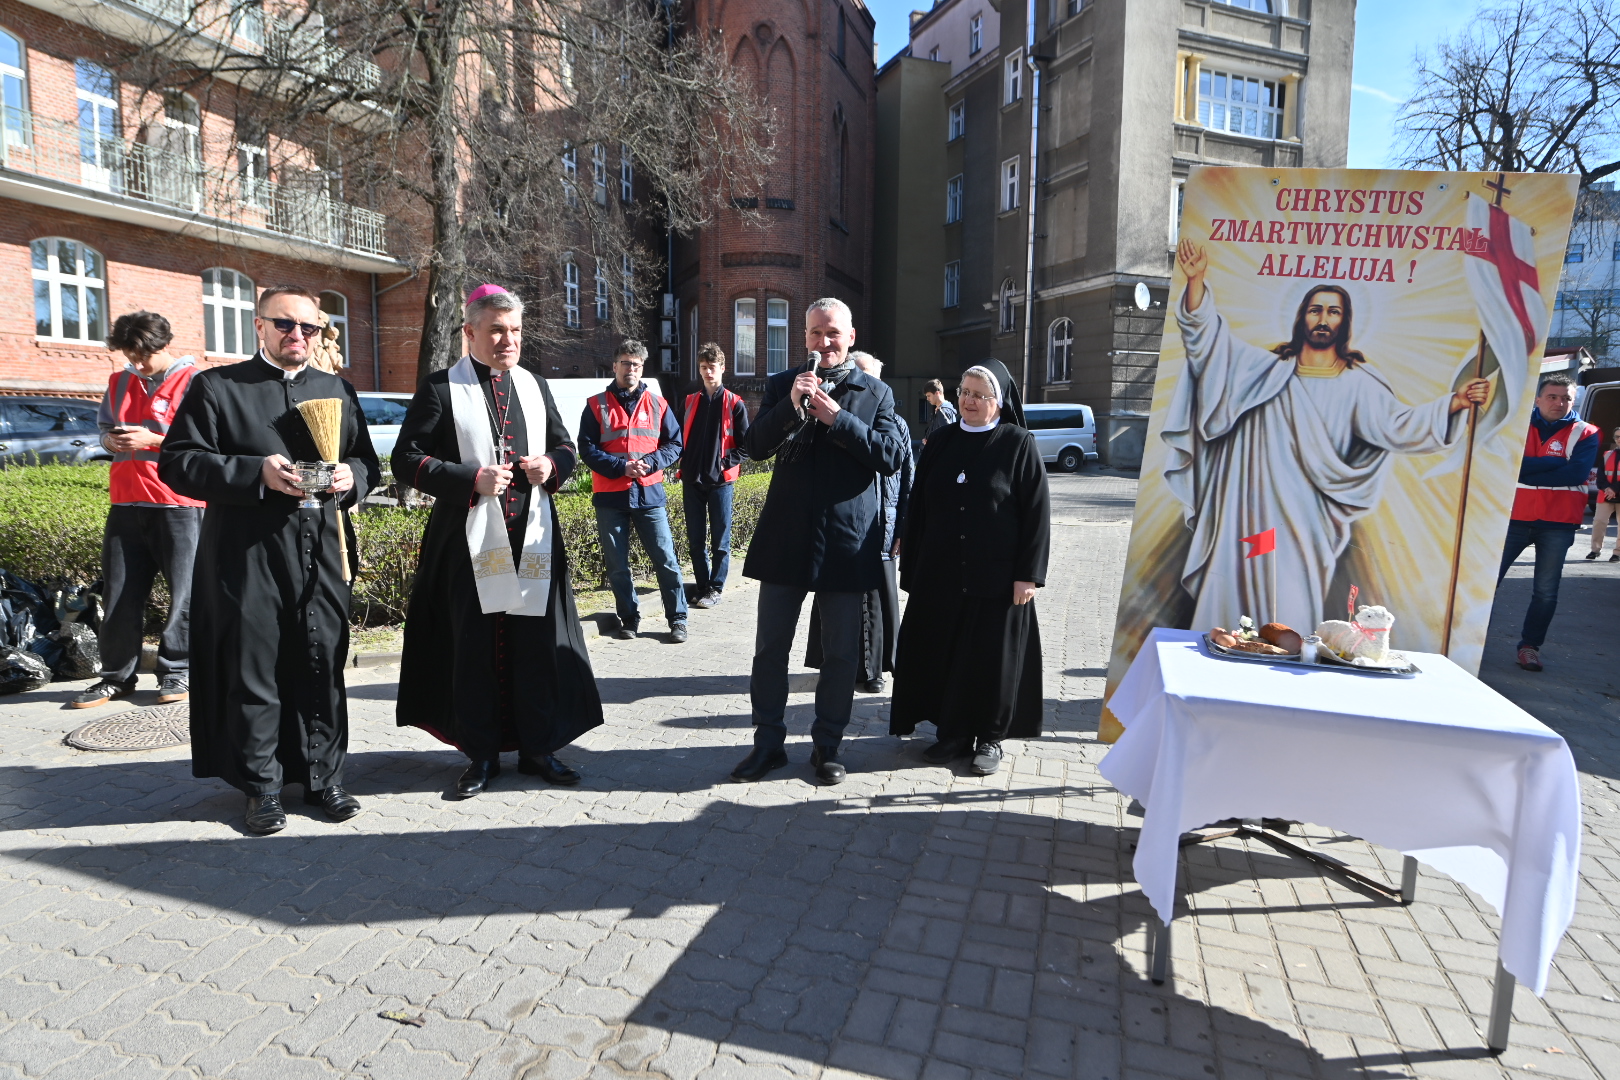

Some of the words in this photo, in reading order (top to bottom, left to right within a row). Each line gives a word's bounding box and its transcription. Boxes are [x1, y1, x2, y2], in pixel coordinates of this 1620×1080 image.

[1275, 187, 1425, 216] CHRYSTUS
[1208, 218, 1488, 253] ZMARTWYCHWSTAŁ
[1257, 253, 1396, 283] ALLELUJA
